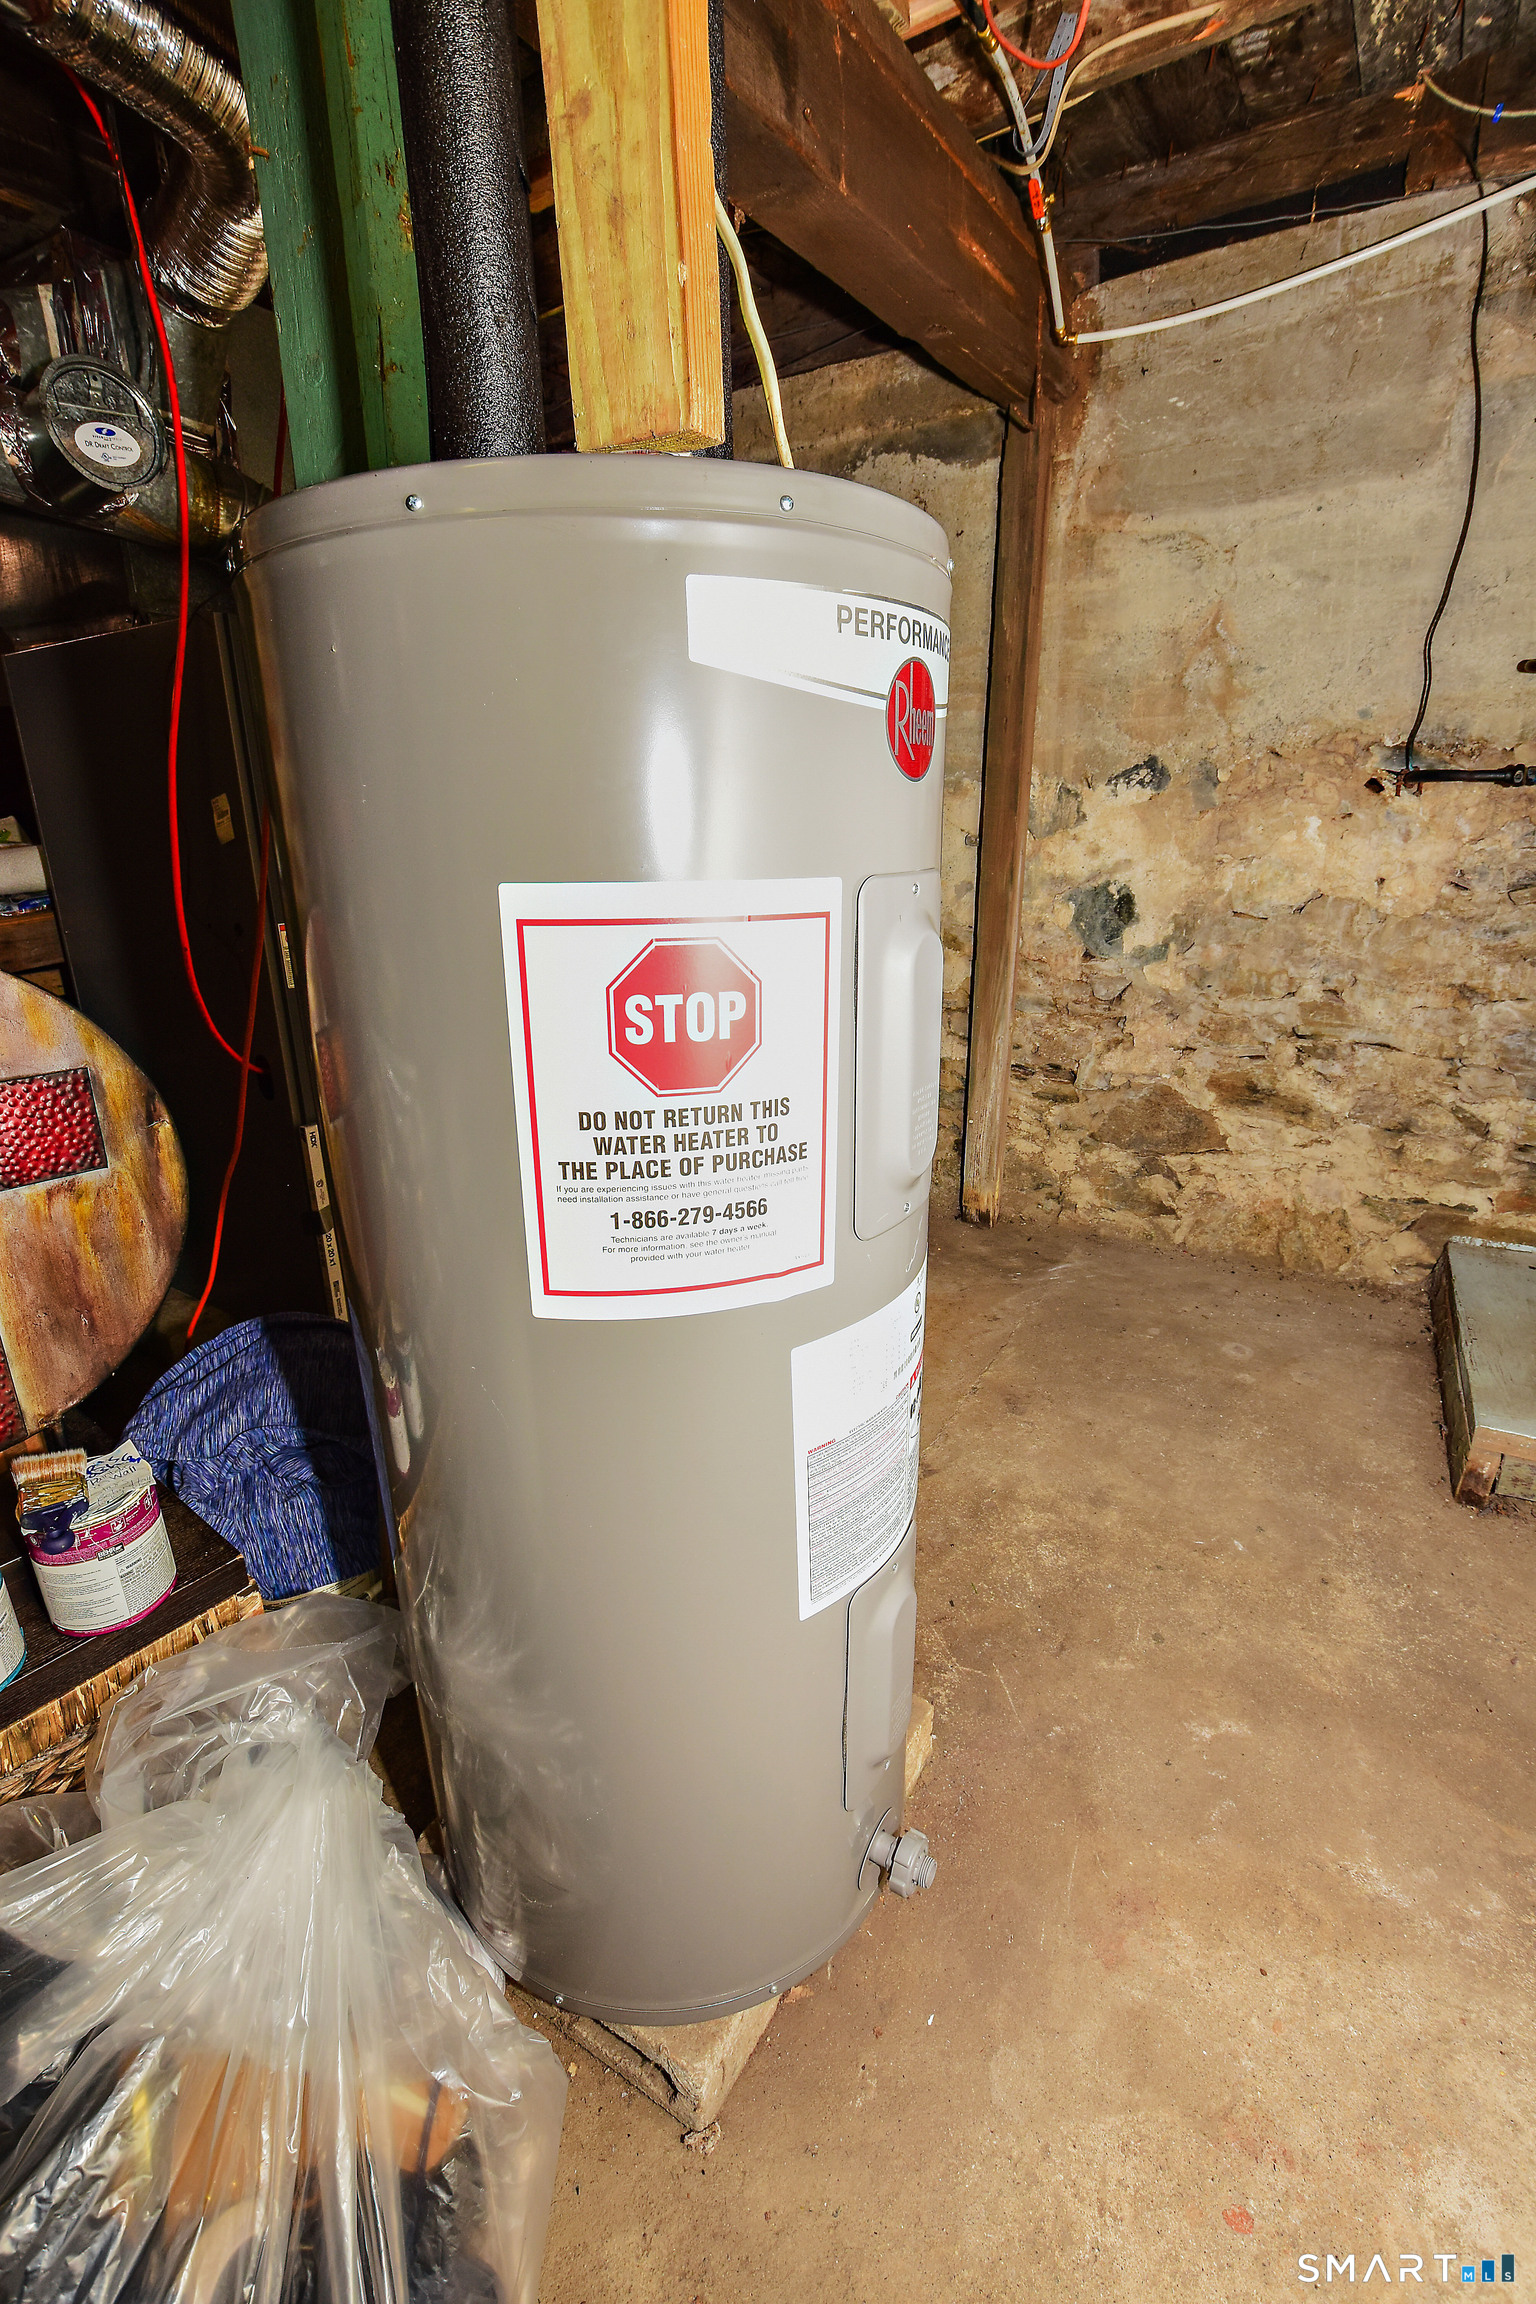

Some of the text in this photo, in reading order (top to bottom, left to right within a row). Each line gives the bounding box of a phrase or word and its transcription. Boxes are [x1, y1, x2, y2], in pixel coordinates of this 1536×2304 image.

[894, 661, 934, 761] Rheem
[625, 991, 747, 1045] STOP
[578, 1097, 790, 1131] DO NOT RETURN THIS
[593, 1123, 778, 1156] WATER HEATER TO
[558, 1142, 808, 1180] THE PLACE OF PURCHASE
[557, 1195, 578, 1203] need
[580, 1195, 623, 1203] installation
[625, 1193, 669, 1202] assistance
[682, 1191, 701, 1199] have
[702, 1188, 732, 1199] general
[563, 1186, 579, 1194] you
[596, 1185, 649, 1194] experiencing
[697, 1179, 712, 1187] this
[714, 1177, 735, 1185] water
[737, 1174, 760, 1182] heater
[610, 1198, 768, 1230] 1-866-279-4566
[611, 1235, 658, 1243] Technicians
[675, 1230, 710, 1240] available
[719, 1226, 738, 1237] days
[706, 1239, 719, 1247] the
[720, 1235, 749, 1245] owner's
[631, 1254, 665, 1263] provided
[667, 1252, 684, 1260] with
[685, 1250, 702, 1261] your
[704, 1248, 725, 1256] water
[808, 1438, 836, 1455] WARNING
